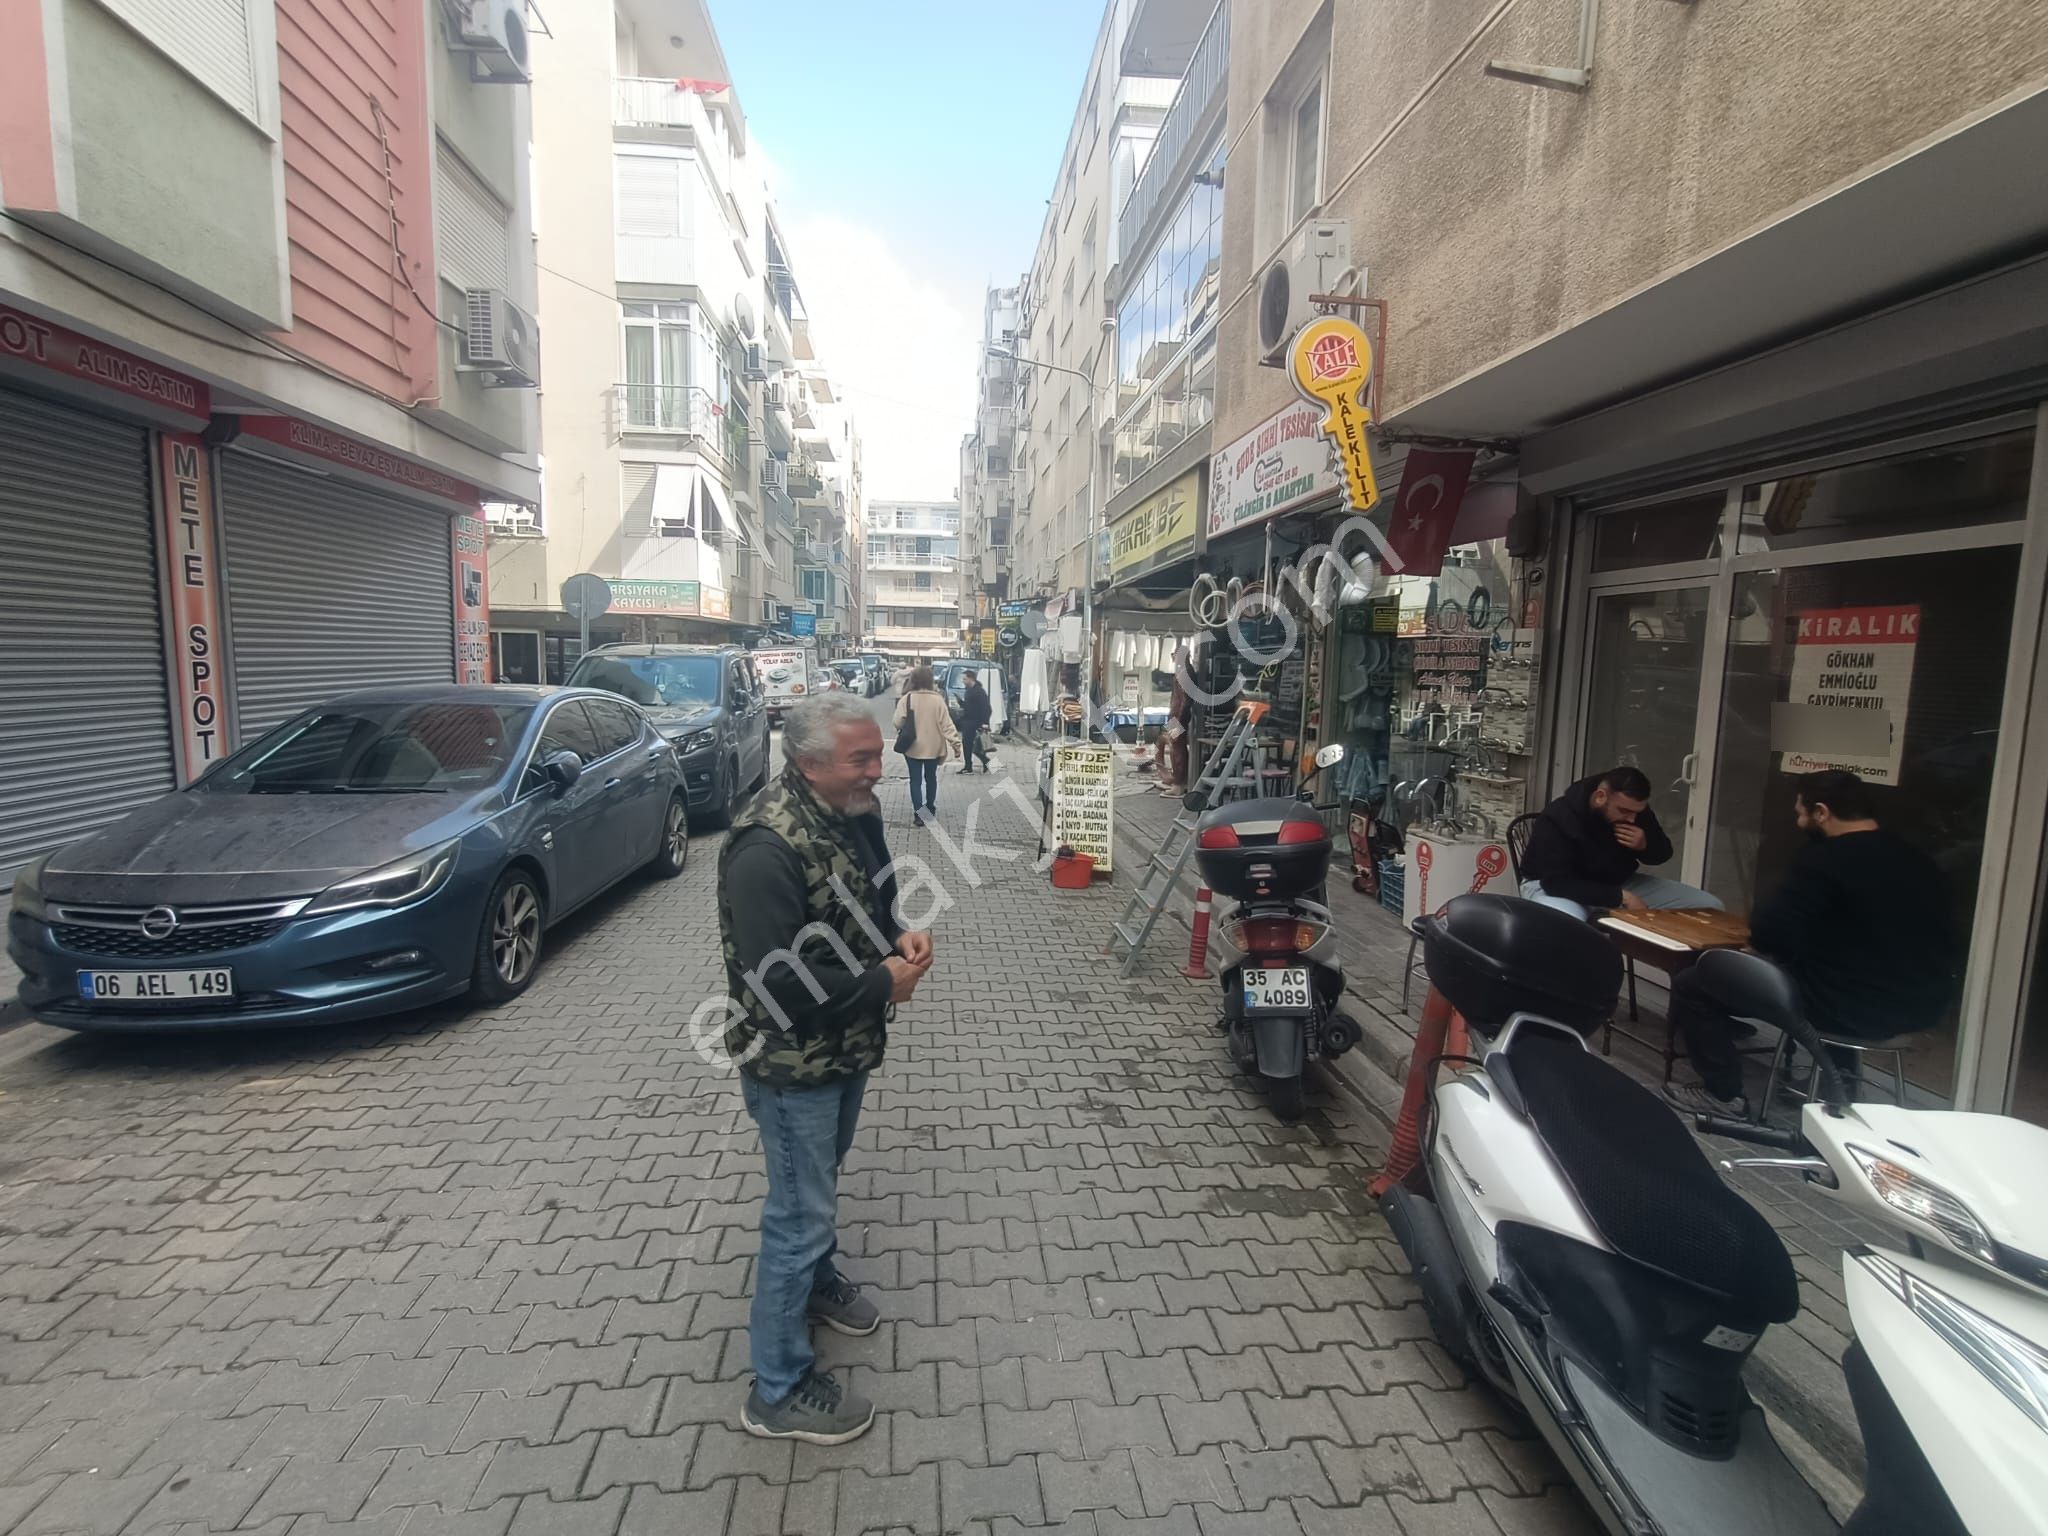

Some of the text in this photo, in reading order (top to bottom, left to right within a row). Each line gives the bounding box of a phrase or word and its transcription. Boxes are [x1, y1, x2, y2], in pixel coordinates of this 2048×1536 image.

[1309, 338, 1360, 379] KALE
[173, 443, 205, 587] METE
[456, 514, 484, 538] METE
[457, 534, 484, 556] SPOT
[1826, 650, 1875, 669] GÖKHAN
[1818, 671, 1878, 690] EMMİOĞLU
[188, 625, 216, 761] SPOT
[1063, 751, 1106, 763] SUDE
[1083, 811, 1108, 820] BADANA
[1085, 822, 1108, 831] MUTFAK
[95, 972, 228, 996] 06 AEL 149
[1246, 970, 1306, 986] 35 AC
[1263, 989, 1307, 1006] 4089
